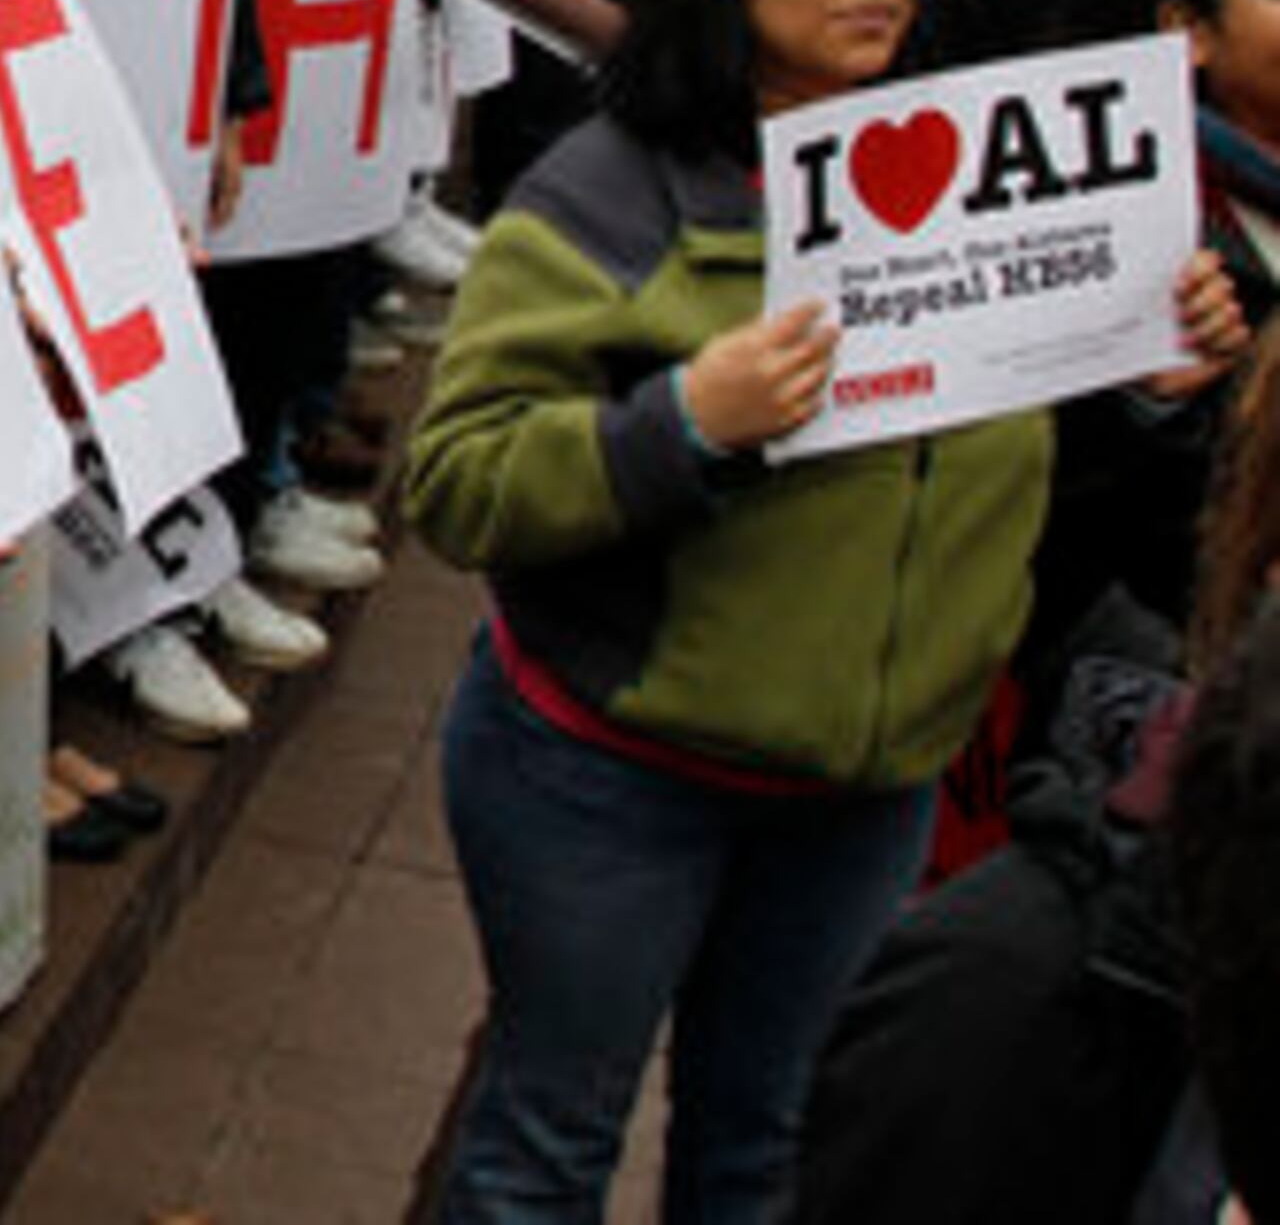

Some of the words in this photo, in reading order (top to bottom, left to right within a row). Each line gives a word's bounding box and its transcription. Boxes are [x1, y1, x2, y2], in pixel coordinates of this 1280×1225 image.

[793, 135, 843, 255] I
[963, 80, 1158, 214] AL
[840, 267, 988, 329] Repeal
